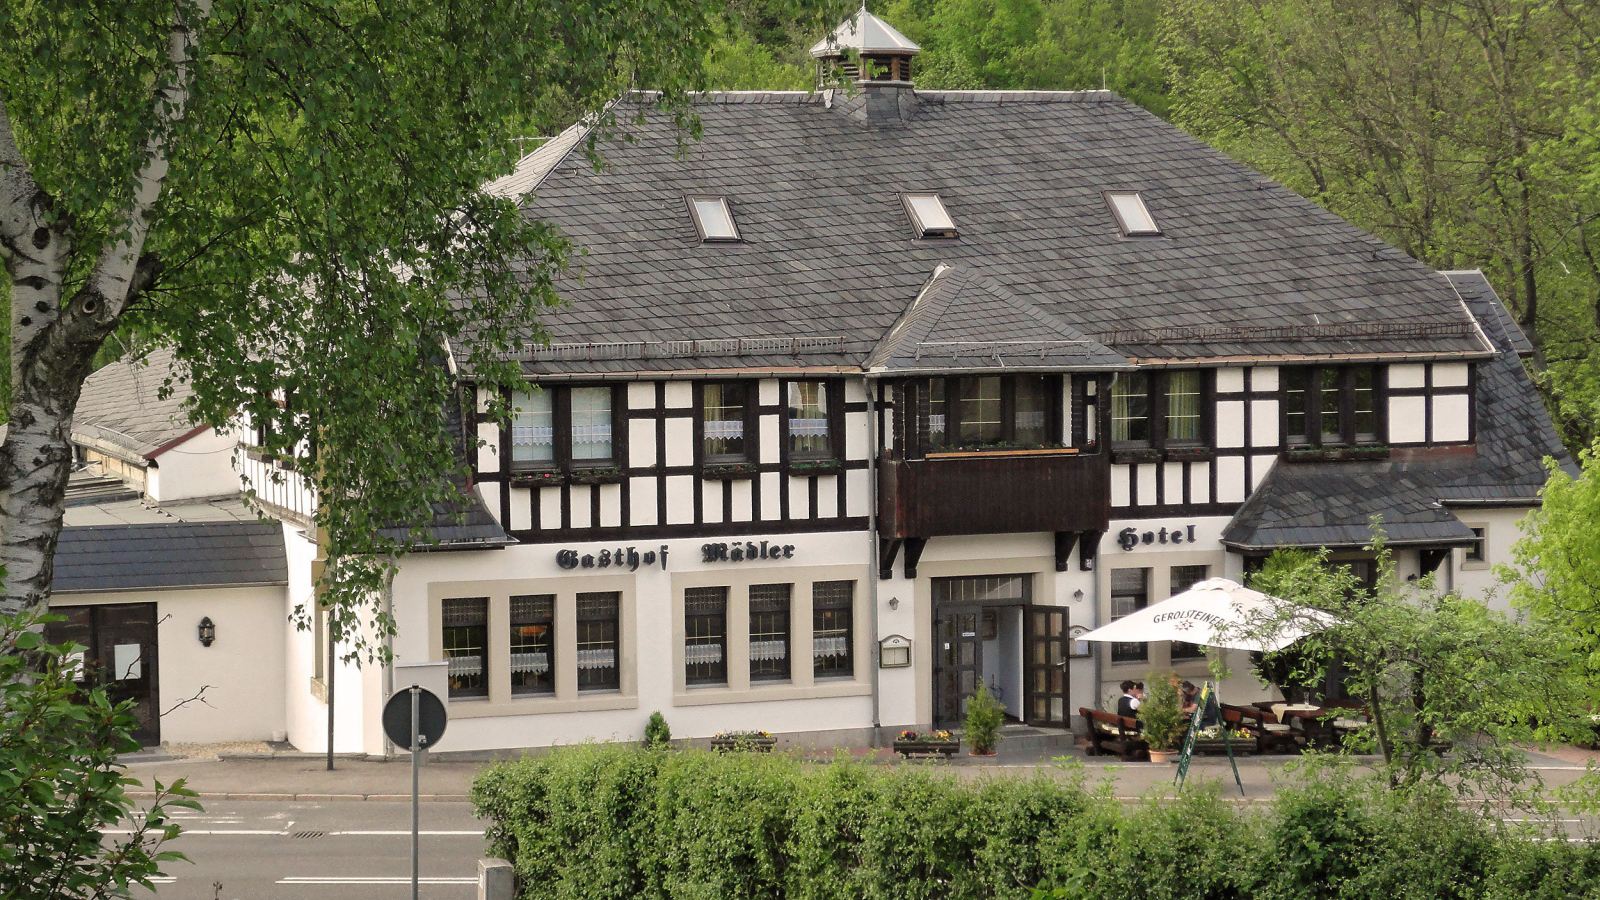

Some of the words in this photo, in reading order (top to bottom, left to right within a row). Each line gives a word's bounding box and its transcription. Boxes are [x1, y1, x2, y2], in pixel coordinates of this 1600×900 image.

[1117, 524, 1197, 551] Hotel
[556, 545, 669, 572] Gasthof
[701, 540, 796, 563] Mädler
